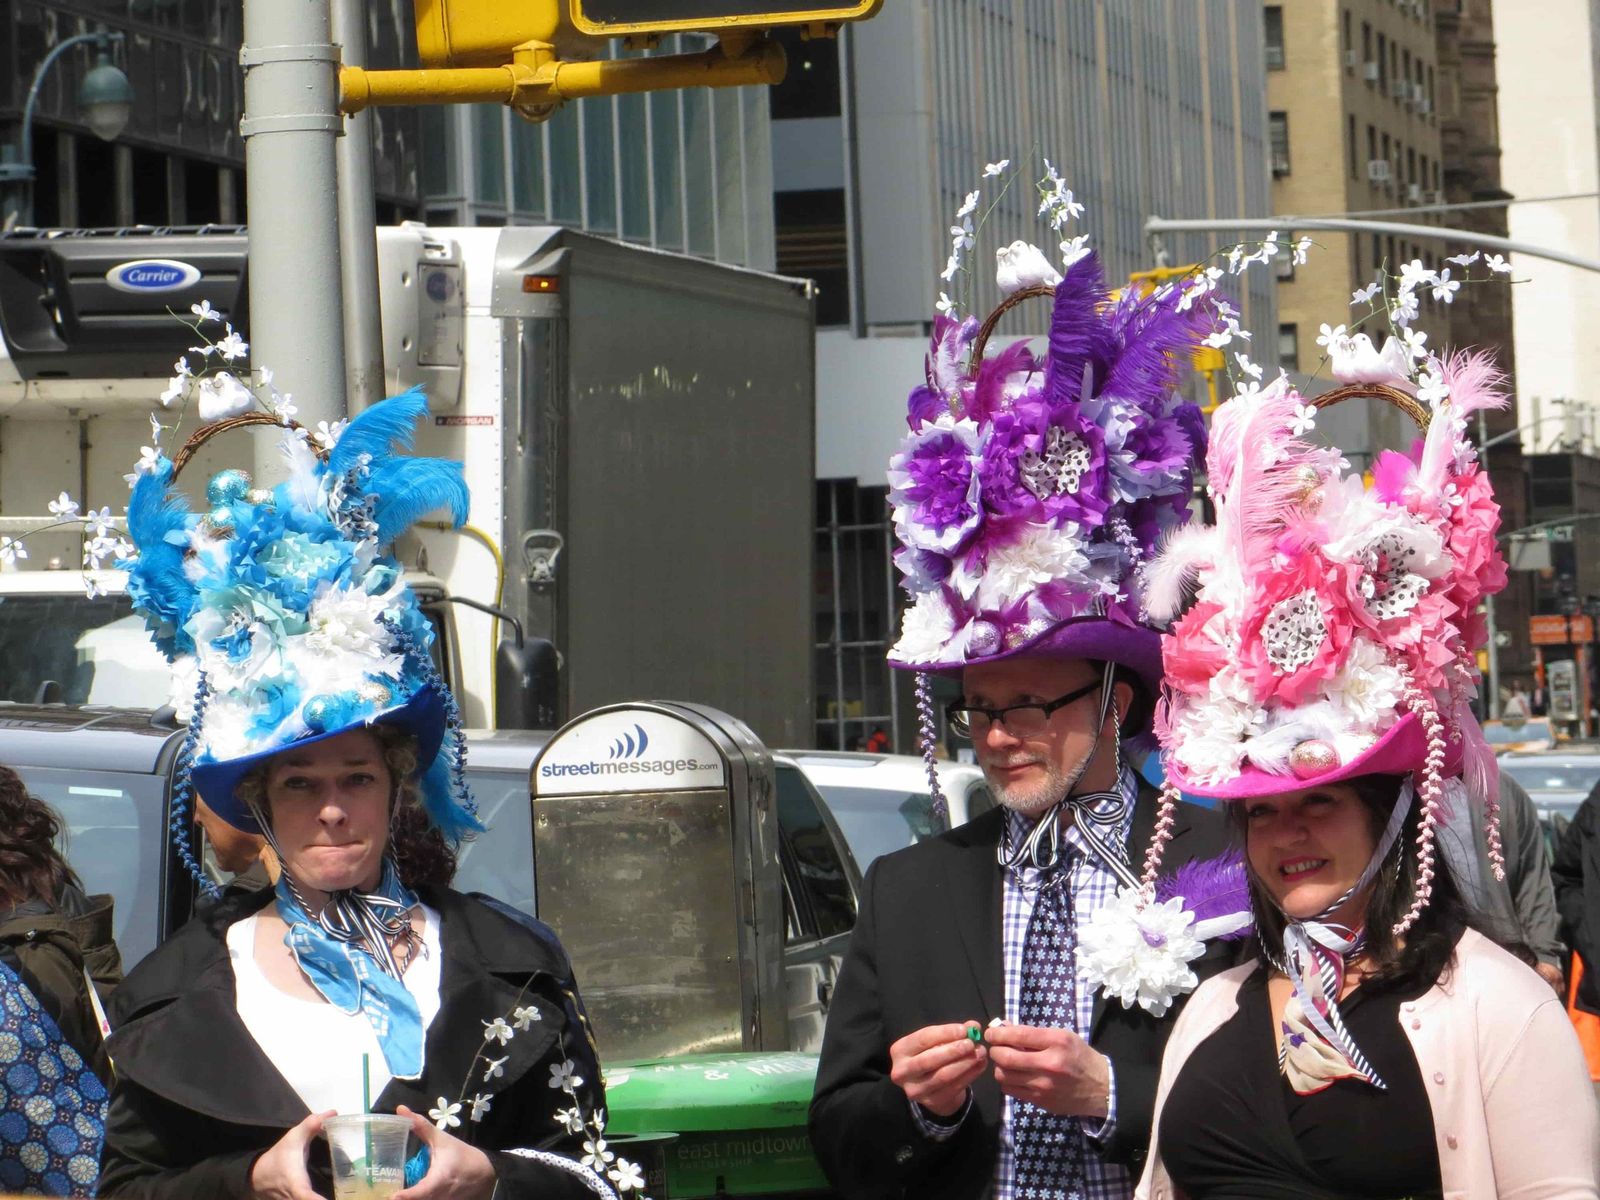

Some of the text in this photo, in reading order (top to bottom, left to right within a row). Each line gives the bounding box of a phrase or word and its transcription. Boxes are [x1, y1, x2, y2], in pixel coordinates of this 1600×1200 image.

[128, 269, 178, 282] Carrier
[542, 758, 718, 777] streetmessages.com
[704, 1069, 729, 1080] &
[678, 1141, 720, 1159] east
